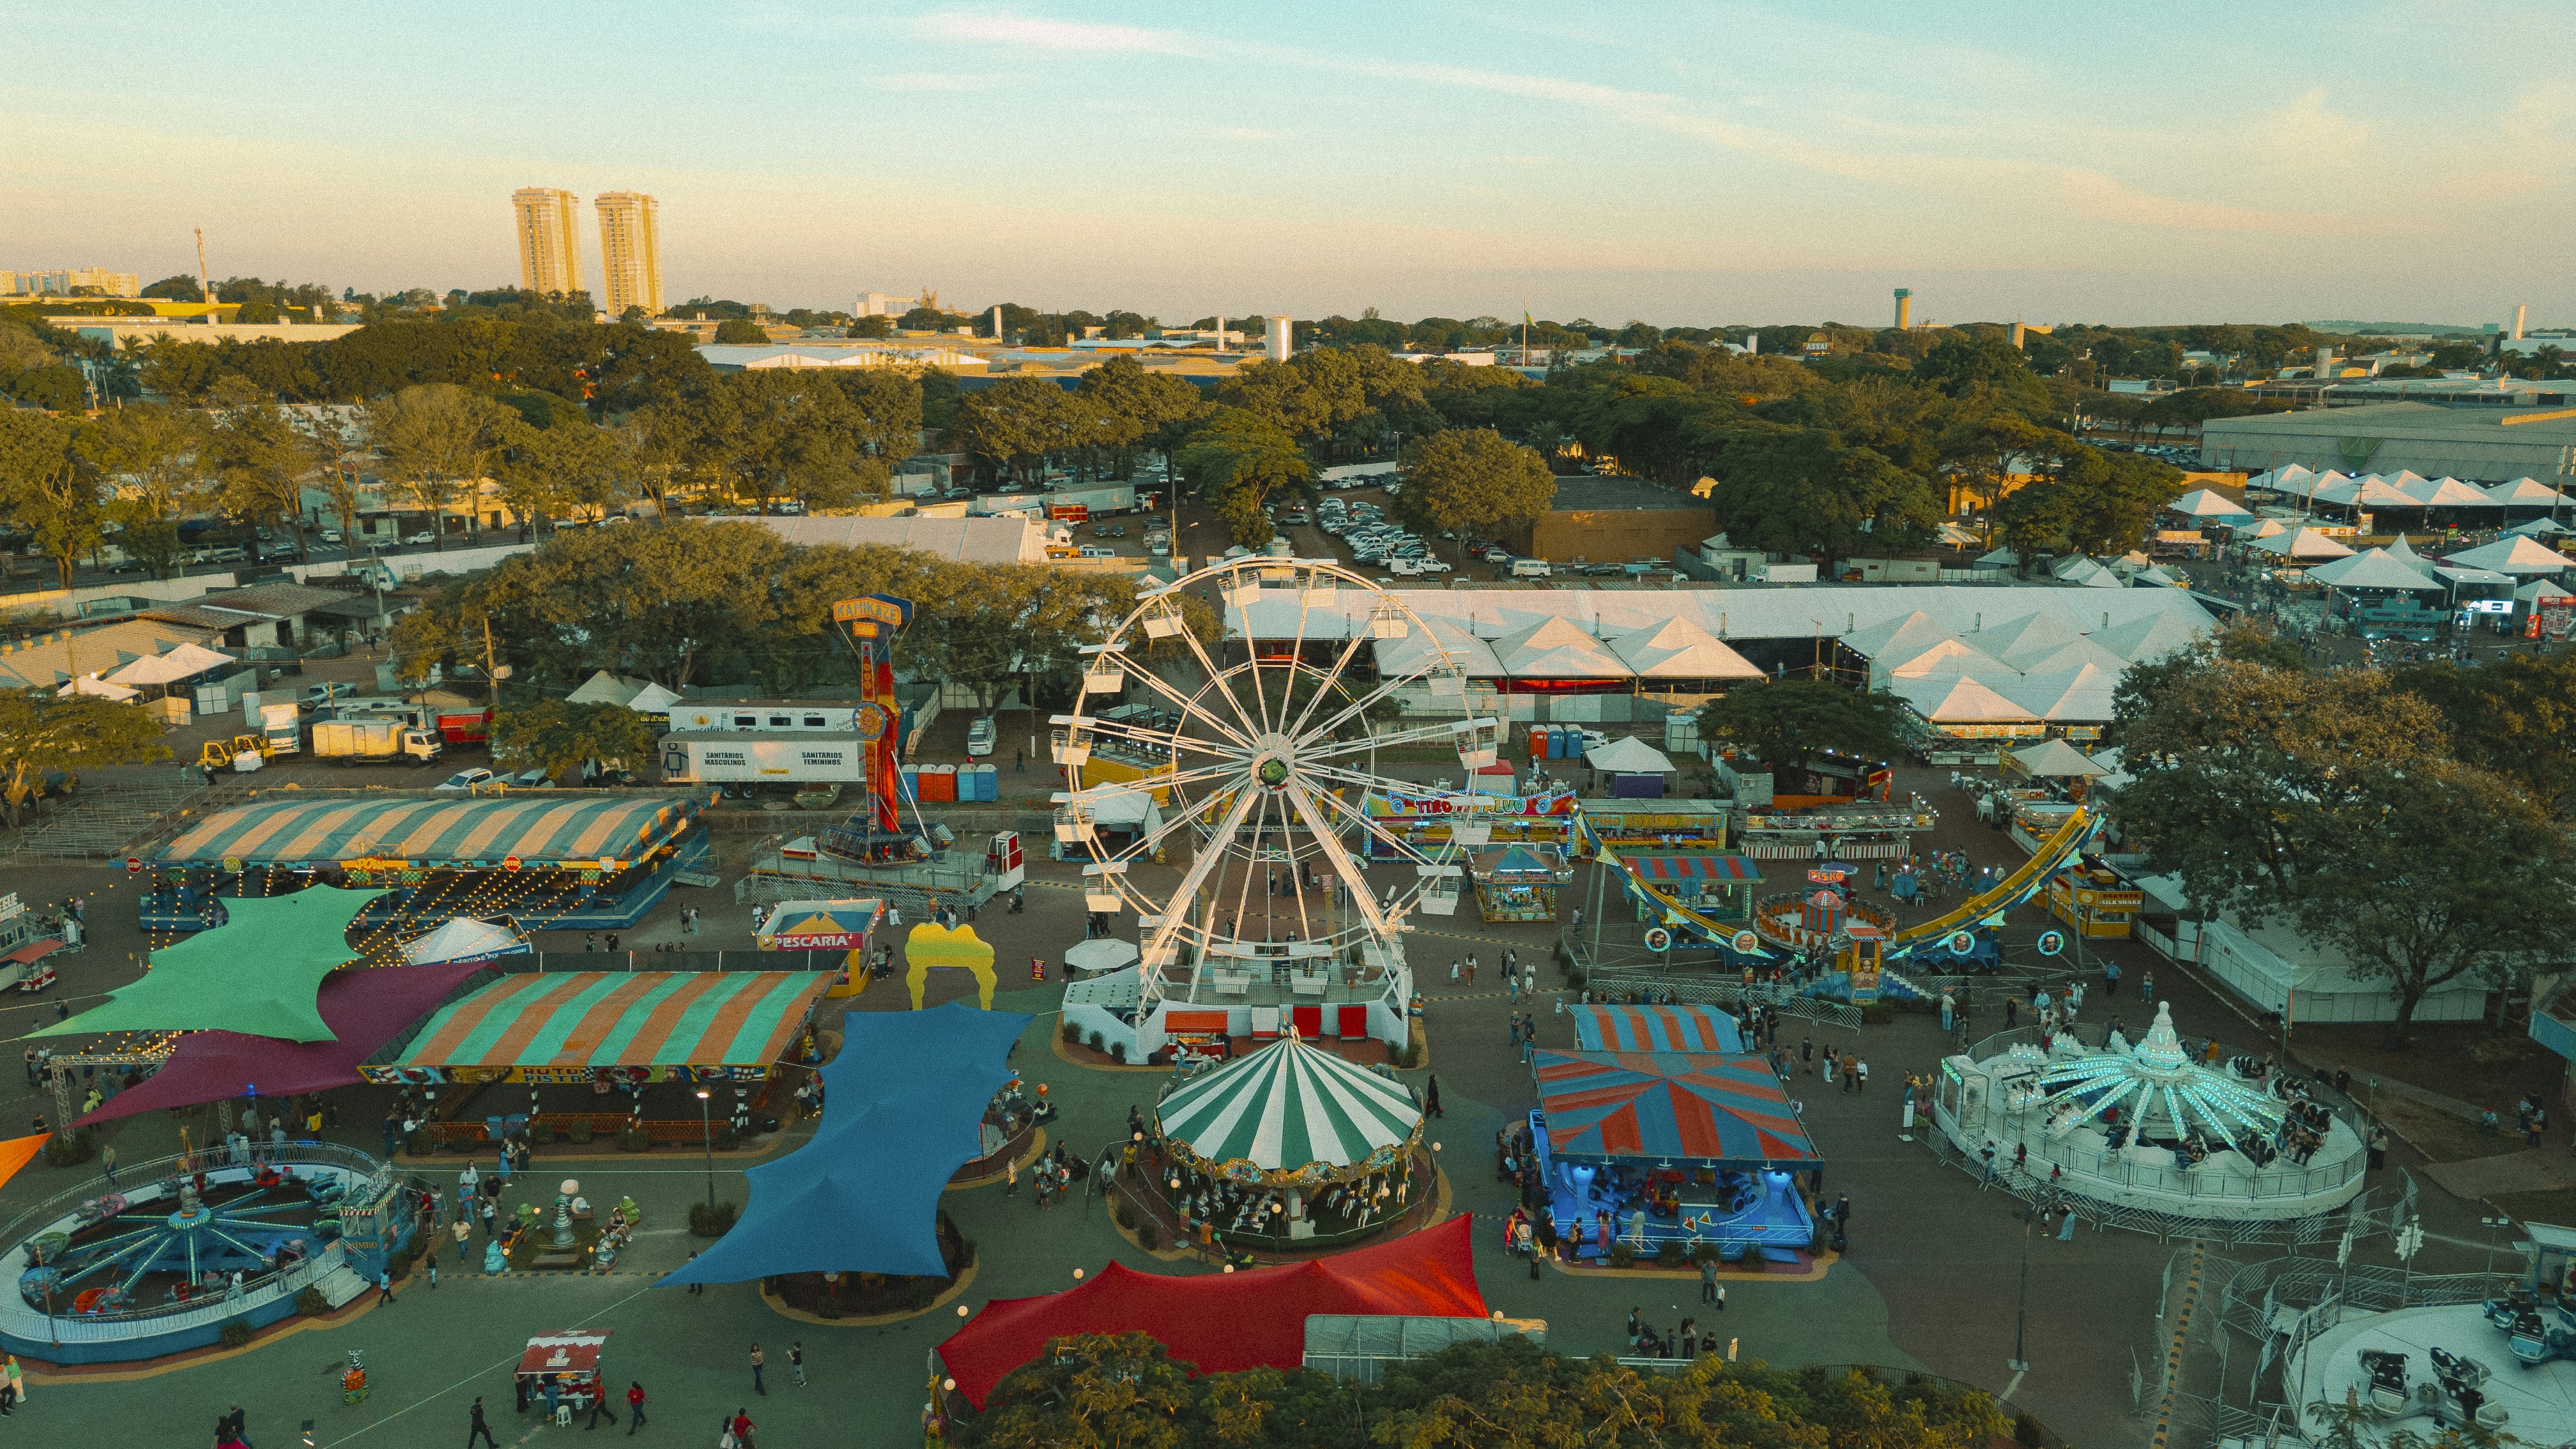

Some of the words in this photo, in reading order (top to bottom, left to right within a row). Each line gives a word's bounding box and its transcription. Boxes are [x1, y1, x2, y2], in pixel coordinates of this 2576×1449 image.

[837, 602, 897, 622] KAMIKAZE
[1415, 799, 1453, 815] TIRO
[1588, 816, 1621, 827] TIRO
[1623, 816, 1643, 827] AO
[1680, 816, 1724, 827] SPORT
[775, 935, 848, 948] PESCARIA
[525, 1075, 582, 1083] PISTA
